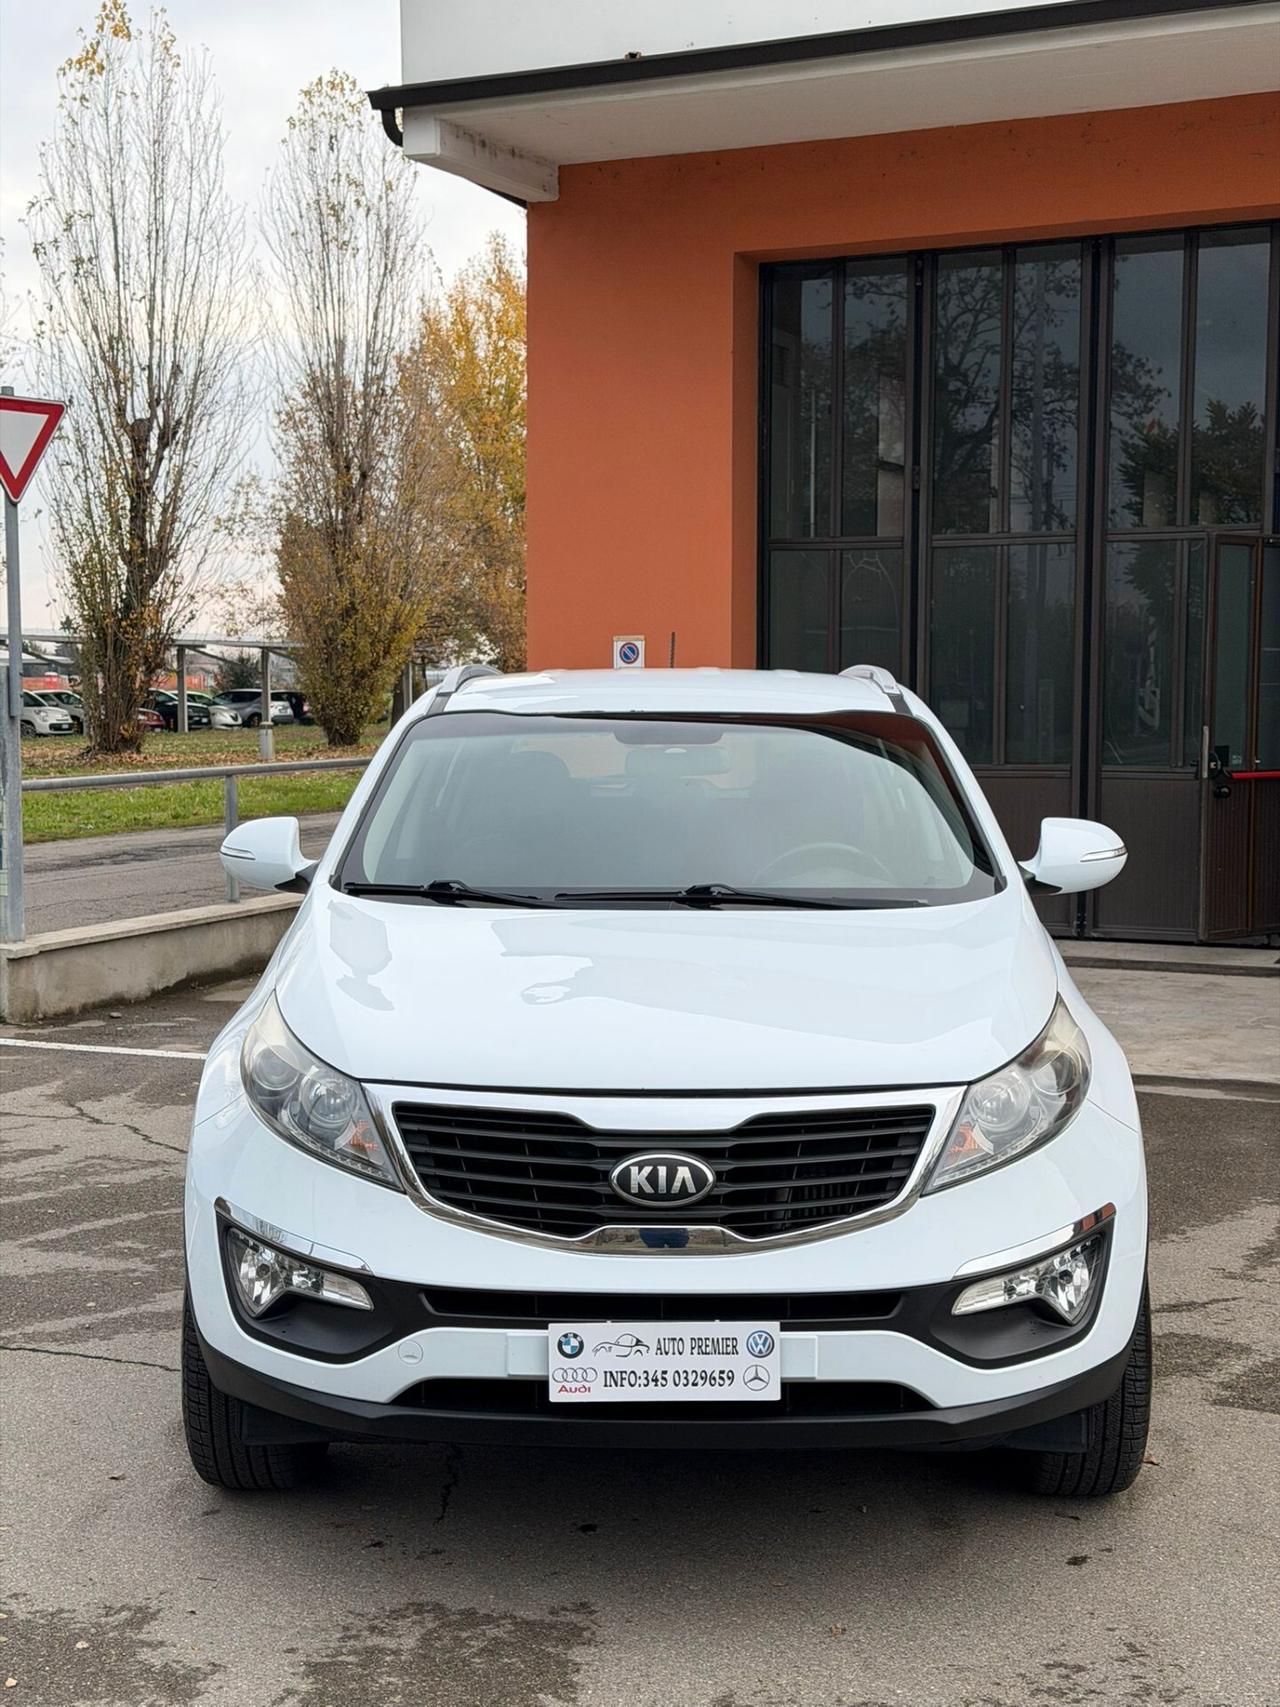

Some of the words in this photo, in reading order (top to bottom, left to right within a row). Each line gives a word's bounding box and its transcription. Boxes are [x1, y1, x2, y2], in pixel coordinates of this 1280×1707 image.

[629, 1166, 697, 1194] KIA
[655, 1337, 685, 1356] AUTO
[690, 1337, 739, 1356] PREMIER
[603, 1369, 668, 1388] INFO:345
[673, 1369, 735, 1388] 0329659
[558, 1384, 591, 1394] Audi
